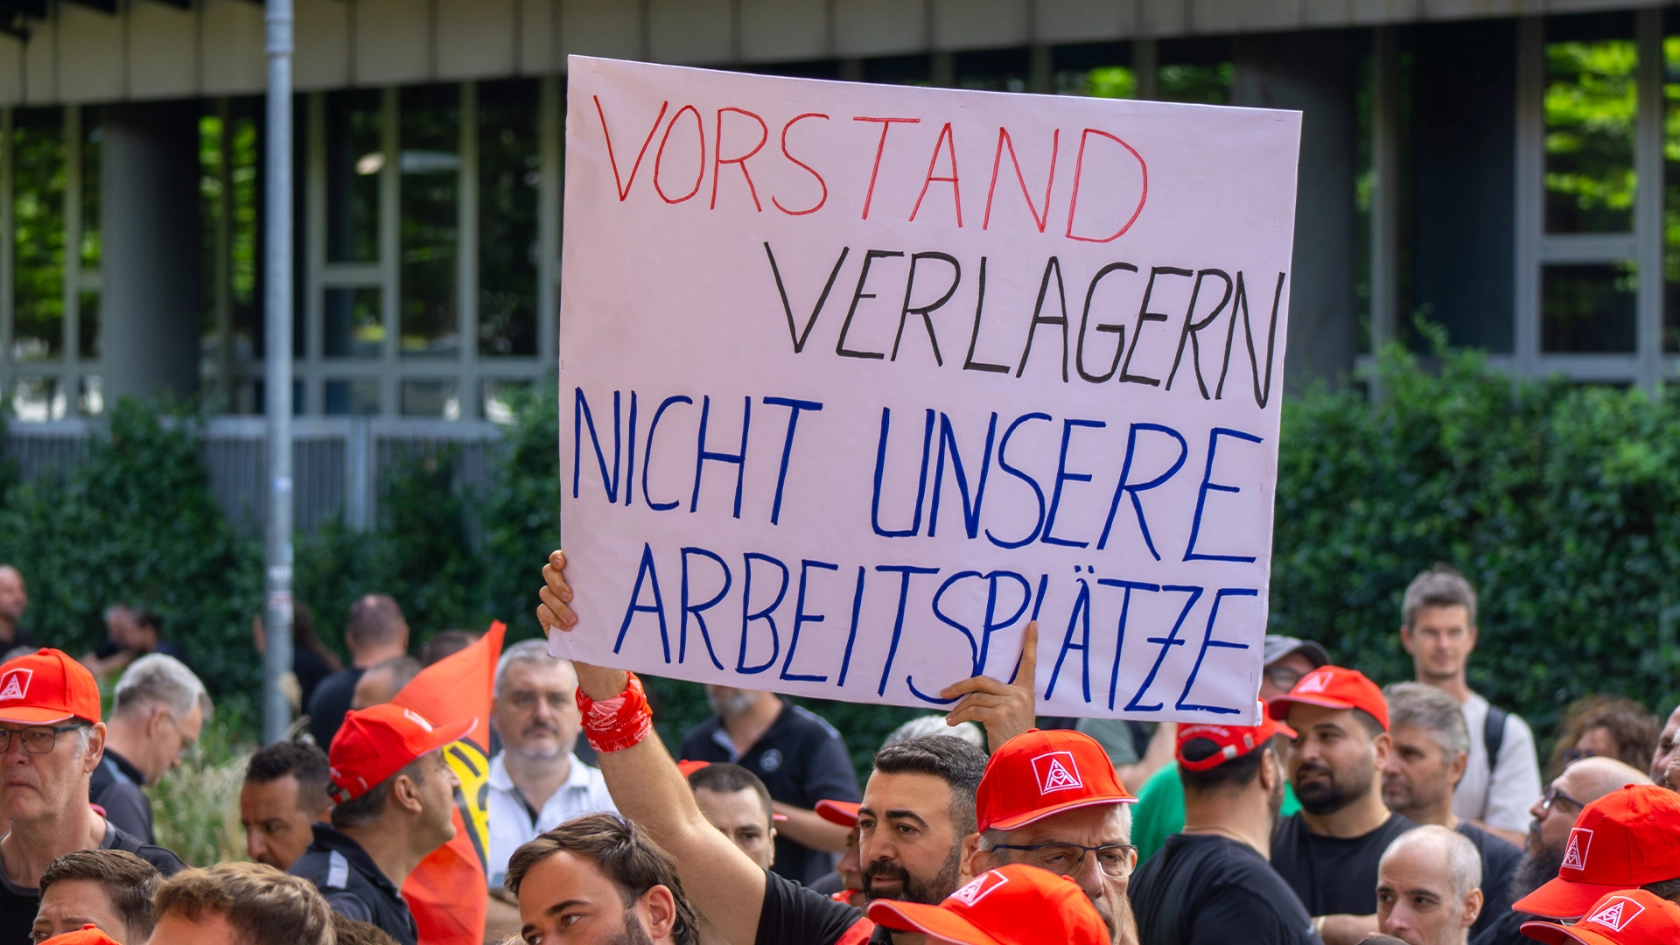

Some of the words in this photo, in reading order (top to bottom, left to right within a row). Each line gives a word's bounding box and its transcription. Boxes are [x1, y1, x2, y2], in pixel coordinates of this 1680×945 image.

[592, 94, 1149, 244] VORSTAND
[763, 241, 1286, 410] VERLAGERN
[572, 386, 824, 526] NICHT
[870, 406, 1265, 565] UNSERE
